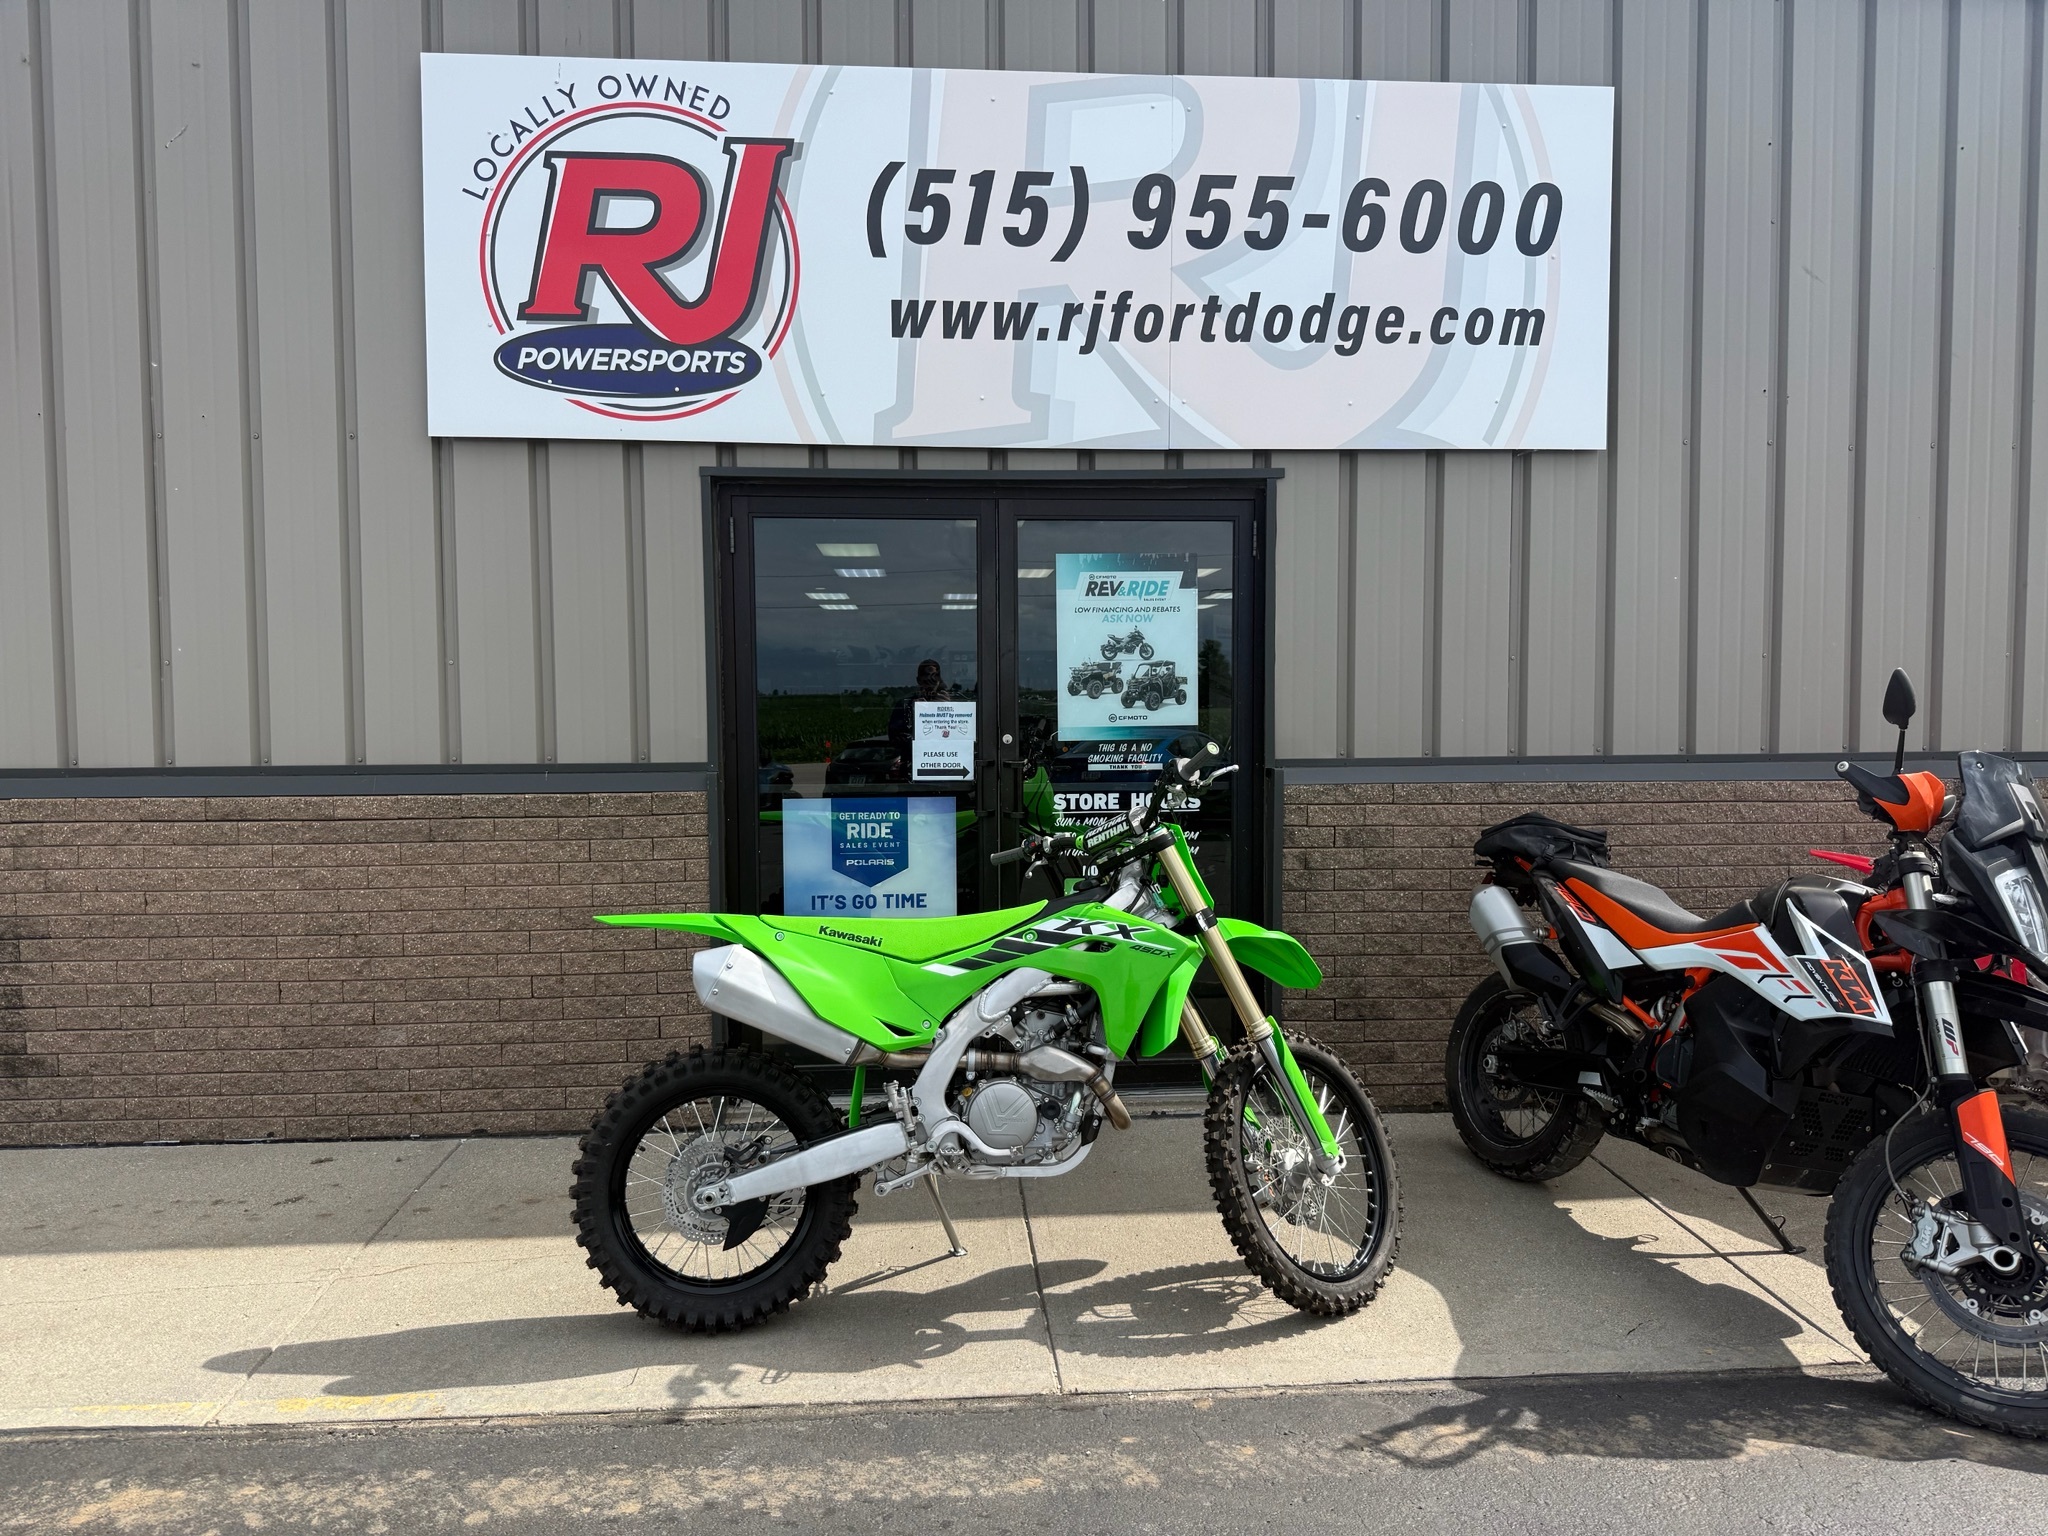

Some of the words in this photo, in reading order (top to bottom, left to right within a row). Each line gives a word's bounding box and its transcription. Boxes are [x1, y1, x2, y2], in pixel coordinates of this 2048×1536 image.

[462, 83, 577, 200] LOCALLY
[597, 73, 731, 120] OWNED
[866, 161, 1091, 262] (515)
[1126, 172, 1563, 256] 955-6000
[517, 137, 798, 345] RJ
[890, 290, 1546, 356] www.rjfortdodge.com
[517, 347, 746, 374] POWERSPORTS
[1074, 606, 1091, 614] LOW
[1092, 606, 1133, 614] FINANCING
[1152, 605, 1181, 613] REBATES
[1101, 614, 1123, 623] ASK
[1125, 614, 1154, 623] NOW
[1098, 743, 1116, 752] THIS
[1119, 743, 1128, 752] IS
[1131, 743, 1137, 752] A
[1140, 743, 1153, 752] NO
[1087, 754, 1124, 763] SMOKING
[1127, 753, 1164, 763] FACILITY
[1053, 792, 1120, 810] STORE
[839, 812, 856, 820] GET
[858, 812, 888, 820] READY
[889, 812, 900, 820] TO
[1054, 817, 1075, 827] SUN
[847, 822, 893, 840] RIDE
[1086, 821, 1130, 848] RENTHAL
[811, 895, 847, 910] IT'S
[852, 894, 877, 910] GO
[882, 893, 927, 909] TIME
[819, 925, 883, 947] Kawasaki
[1053, 919, 1153, 941] KX
[1129, 944, 1176, 958] 450X
[1804, 961, 1839, 1003] ADVENTURE
[1820, 959, 1876, 1015] KTM
